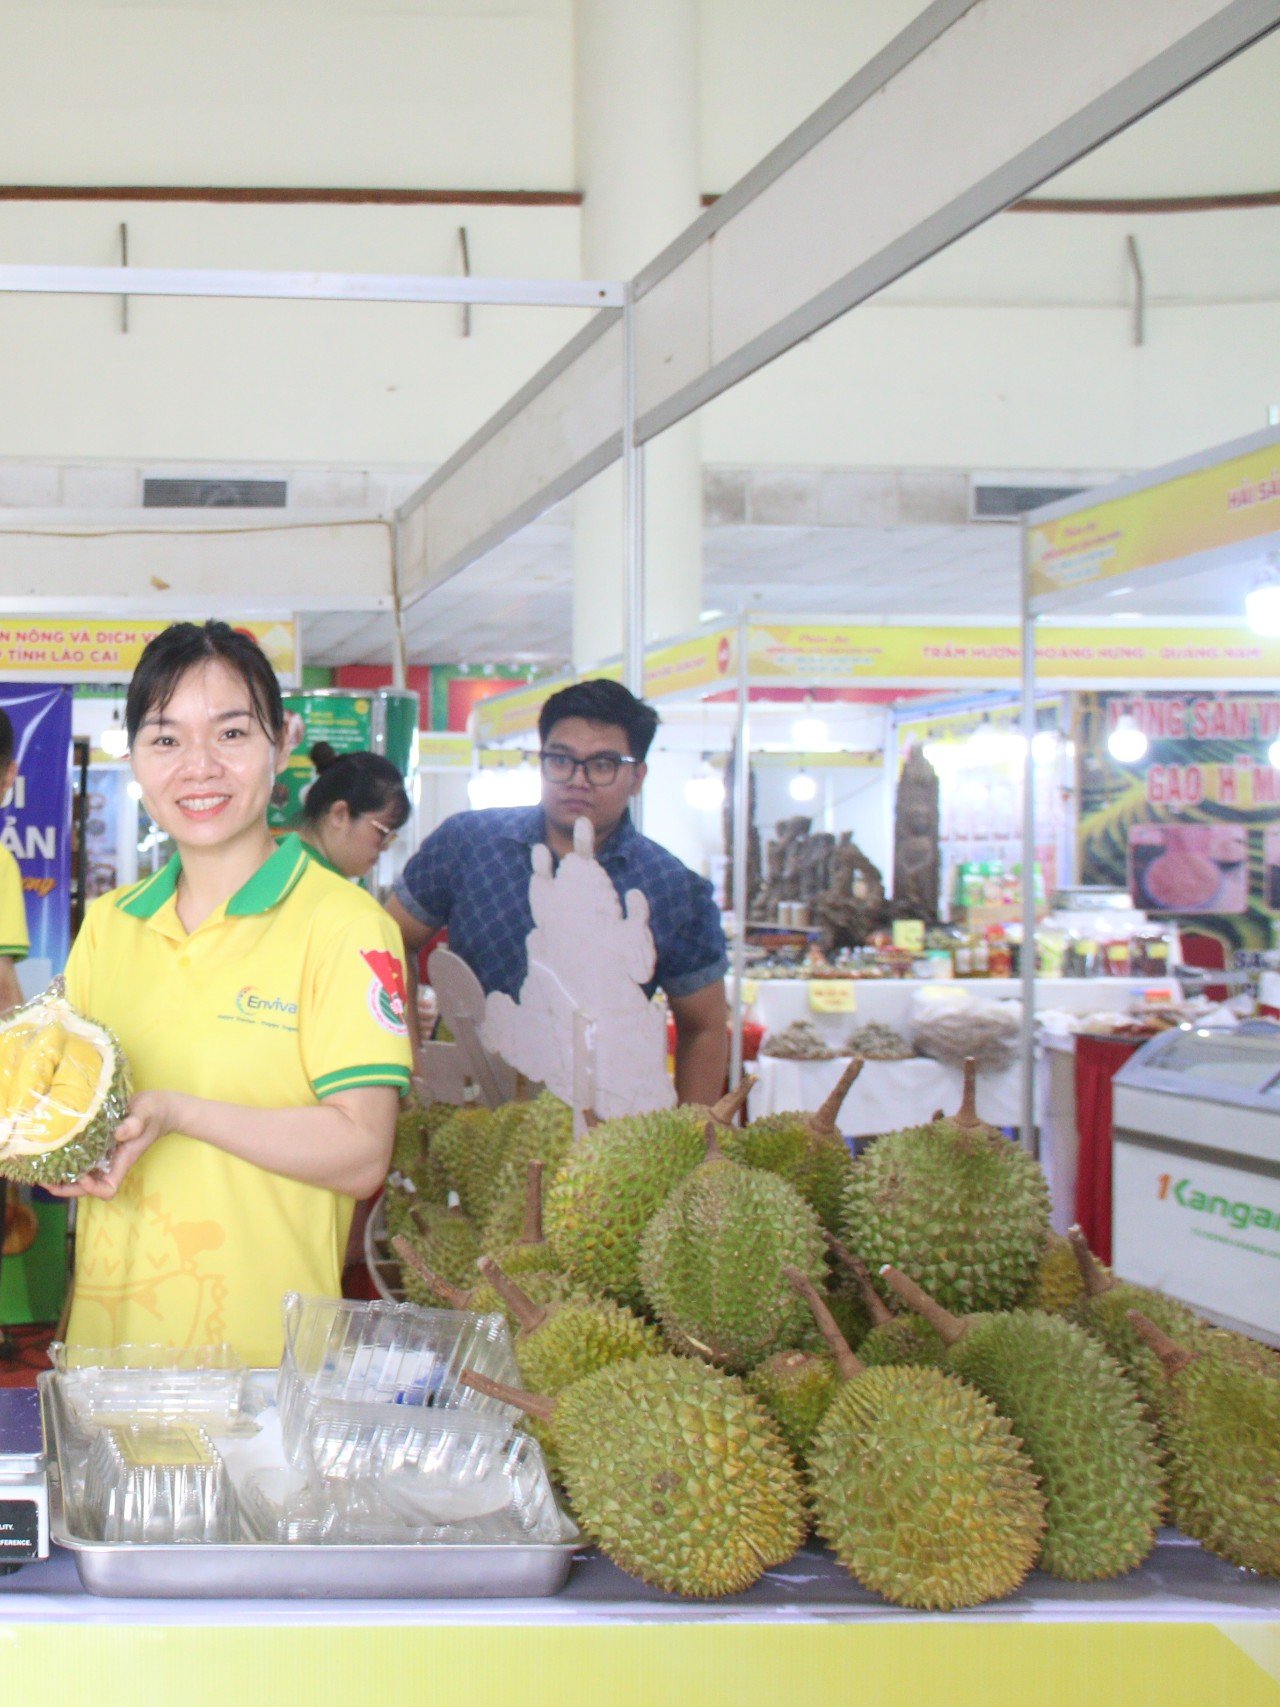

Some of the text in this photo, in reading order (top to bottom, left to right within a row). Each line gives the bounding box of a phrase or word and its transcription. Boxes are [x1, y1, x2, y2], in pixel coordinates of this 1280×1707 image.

[16, 629, 64, 643] NÔNG
[90, 650, 118, 662] CAI
[247, 994, 298, 1015] Enviva
